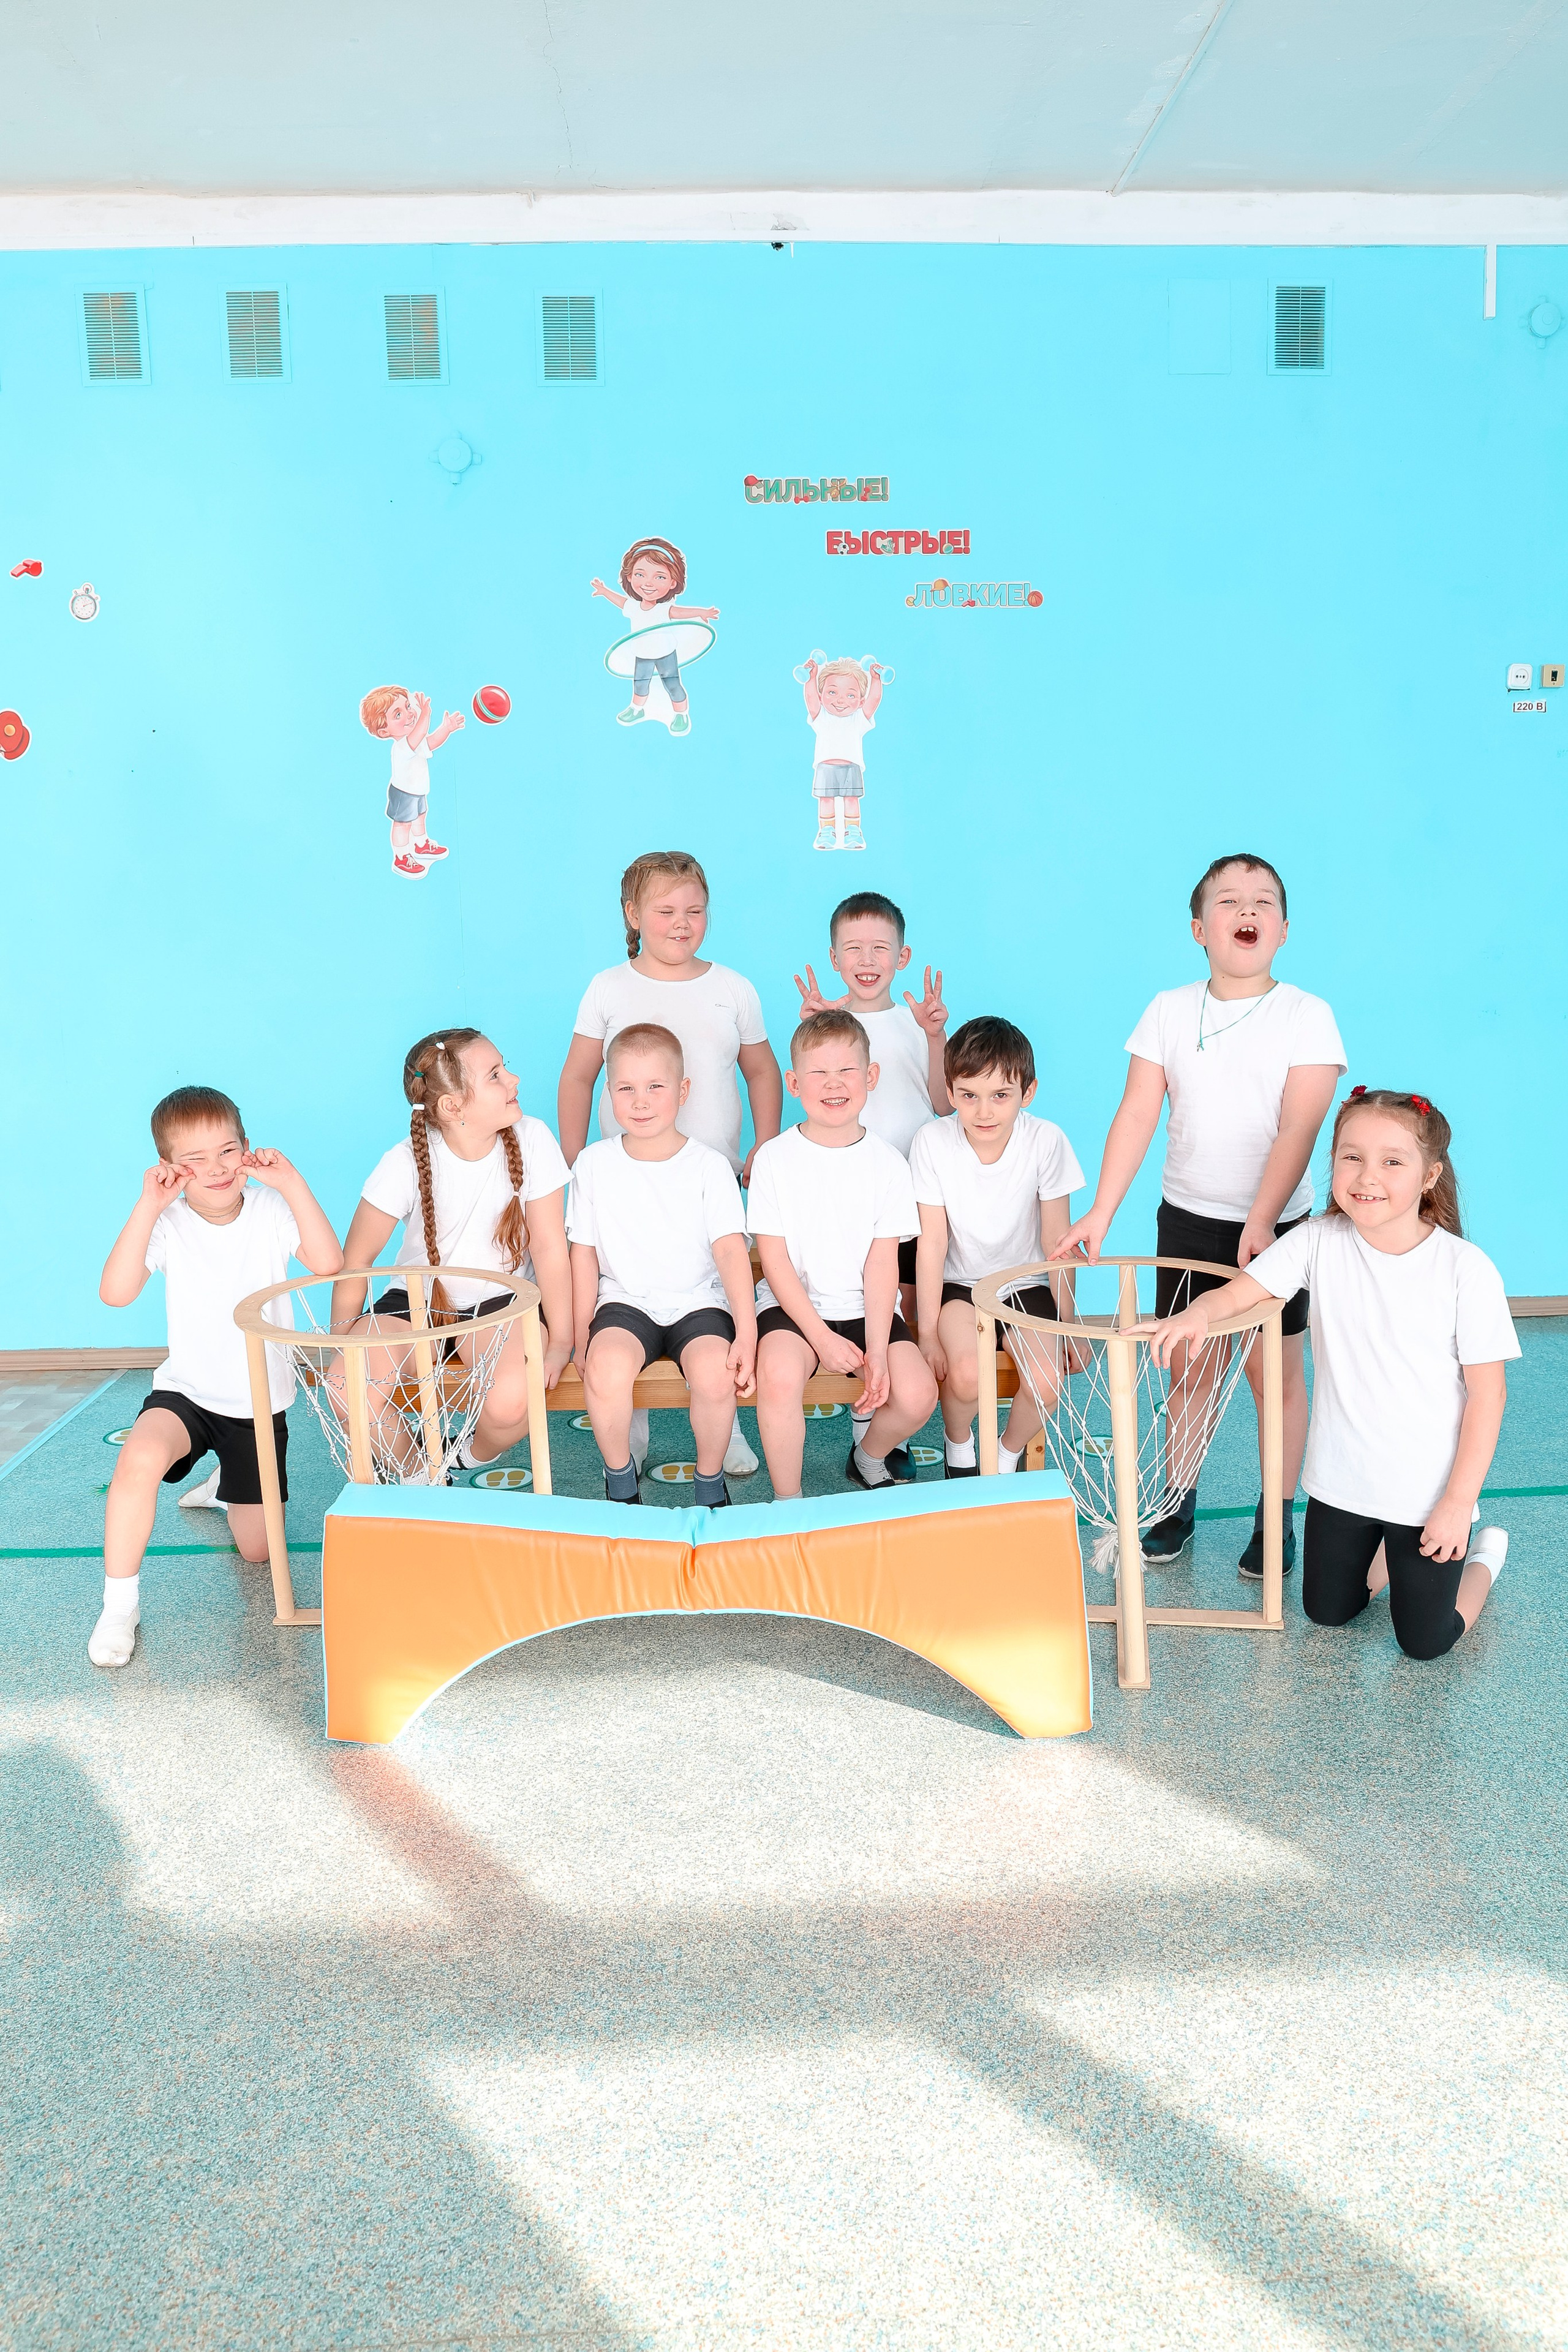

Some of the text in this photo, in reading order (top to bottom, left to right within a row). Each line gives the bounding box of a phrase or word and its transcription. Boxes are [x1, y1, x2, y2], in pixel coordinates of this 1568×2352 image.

[745, 477, 888, 503] СИЛЬНЫЕ!
[827, 530, 970, 554] БЫСТРЫЕ!
[913, 583, 1031, 607] ЛОВКИЕ!
